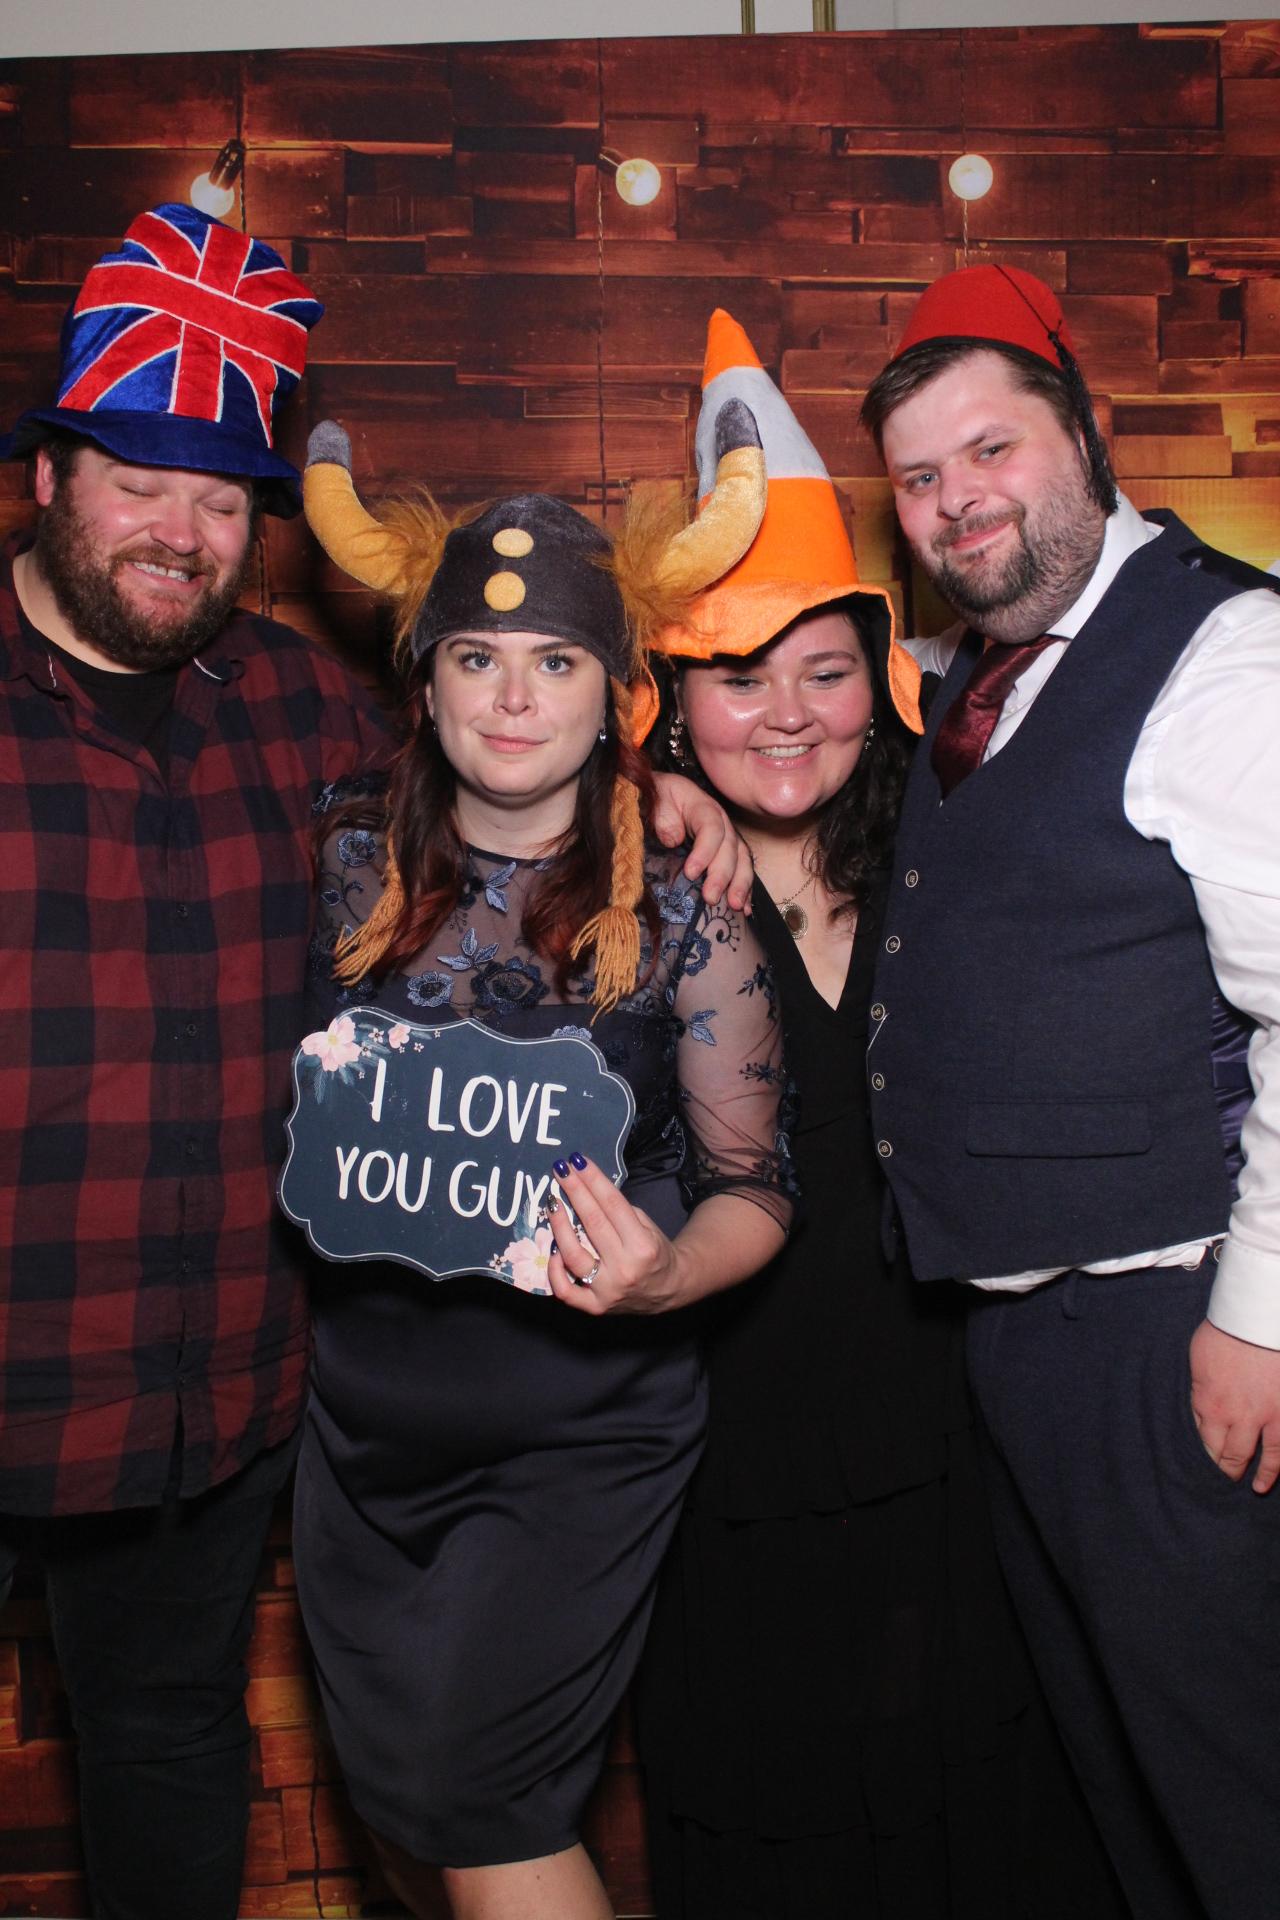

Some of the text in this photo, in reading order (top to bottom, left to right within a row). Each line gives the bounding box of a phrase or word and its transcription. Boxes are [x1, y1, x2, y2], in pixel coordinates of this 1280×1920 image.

[371, 1058, 567, 1146] I LOVE
[336, 1146, 432, 1213] YOU
